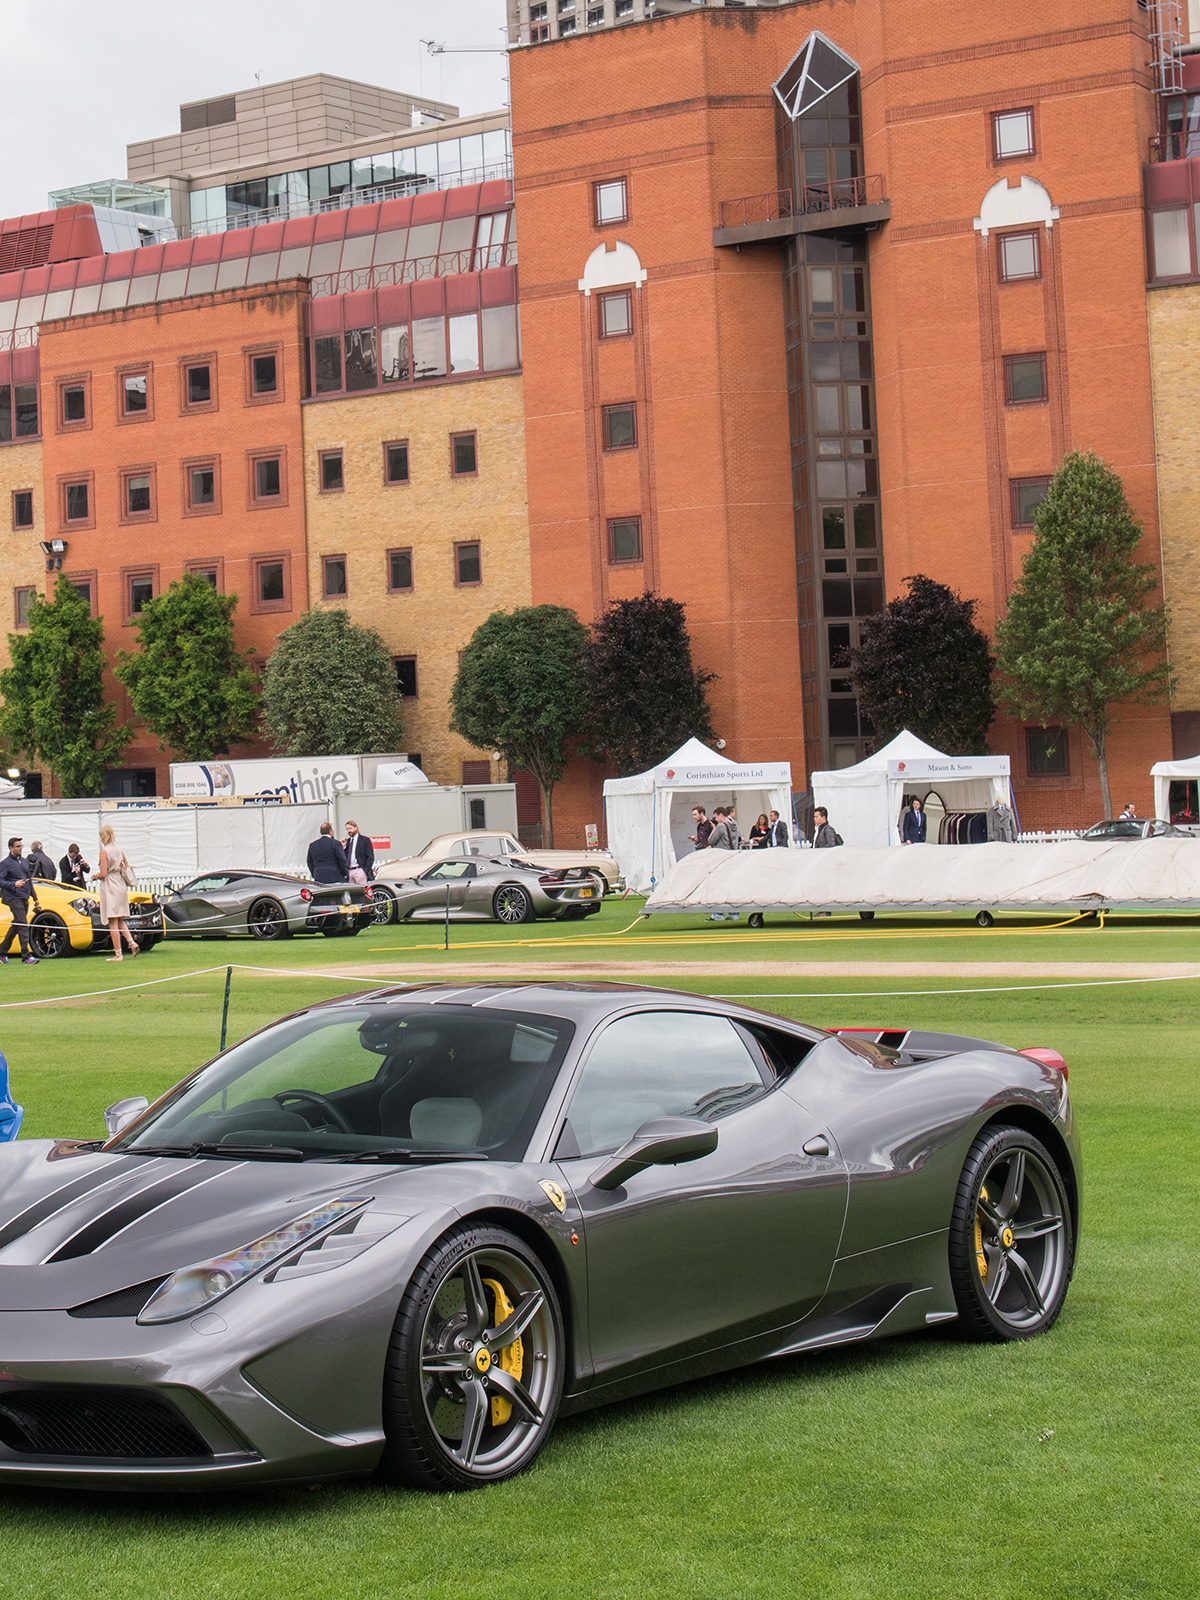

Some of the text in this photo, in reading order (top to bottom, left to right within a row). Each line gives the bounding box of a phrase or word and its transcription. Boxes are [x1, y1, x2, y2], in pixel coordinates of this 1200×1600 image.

[927, 764, 949, 772] Mason
[956, 763, 973, 771] Sons
[685, 769, 763, 780] Corinthian Sports Ltd
[780, 769, 788, 777] 16
